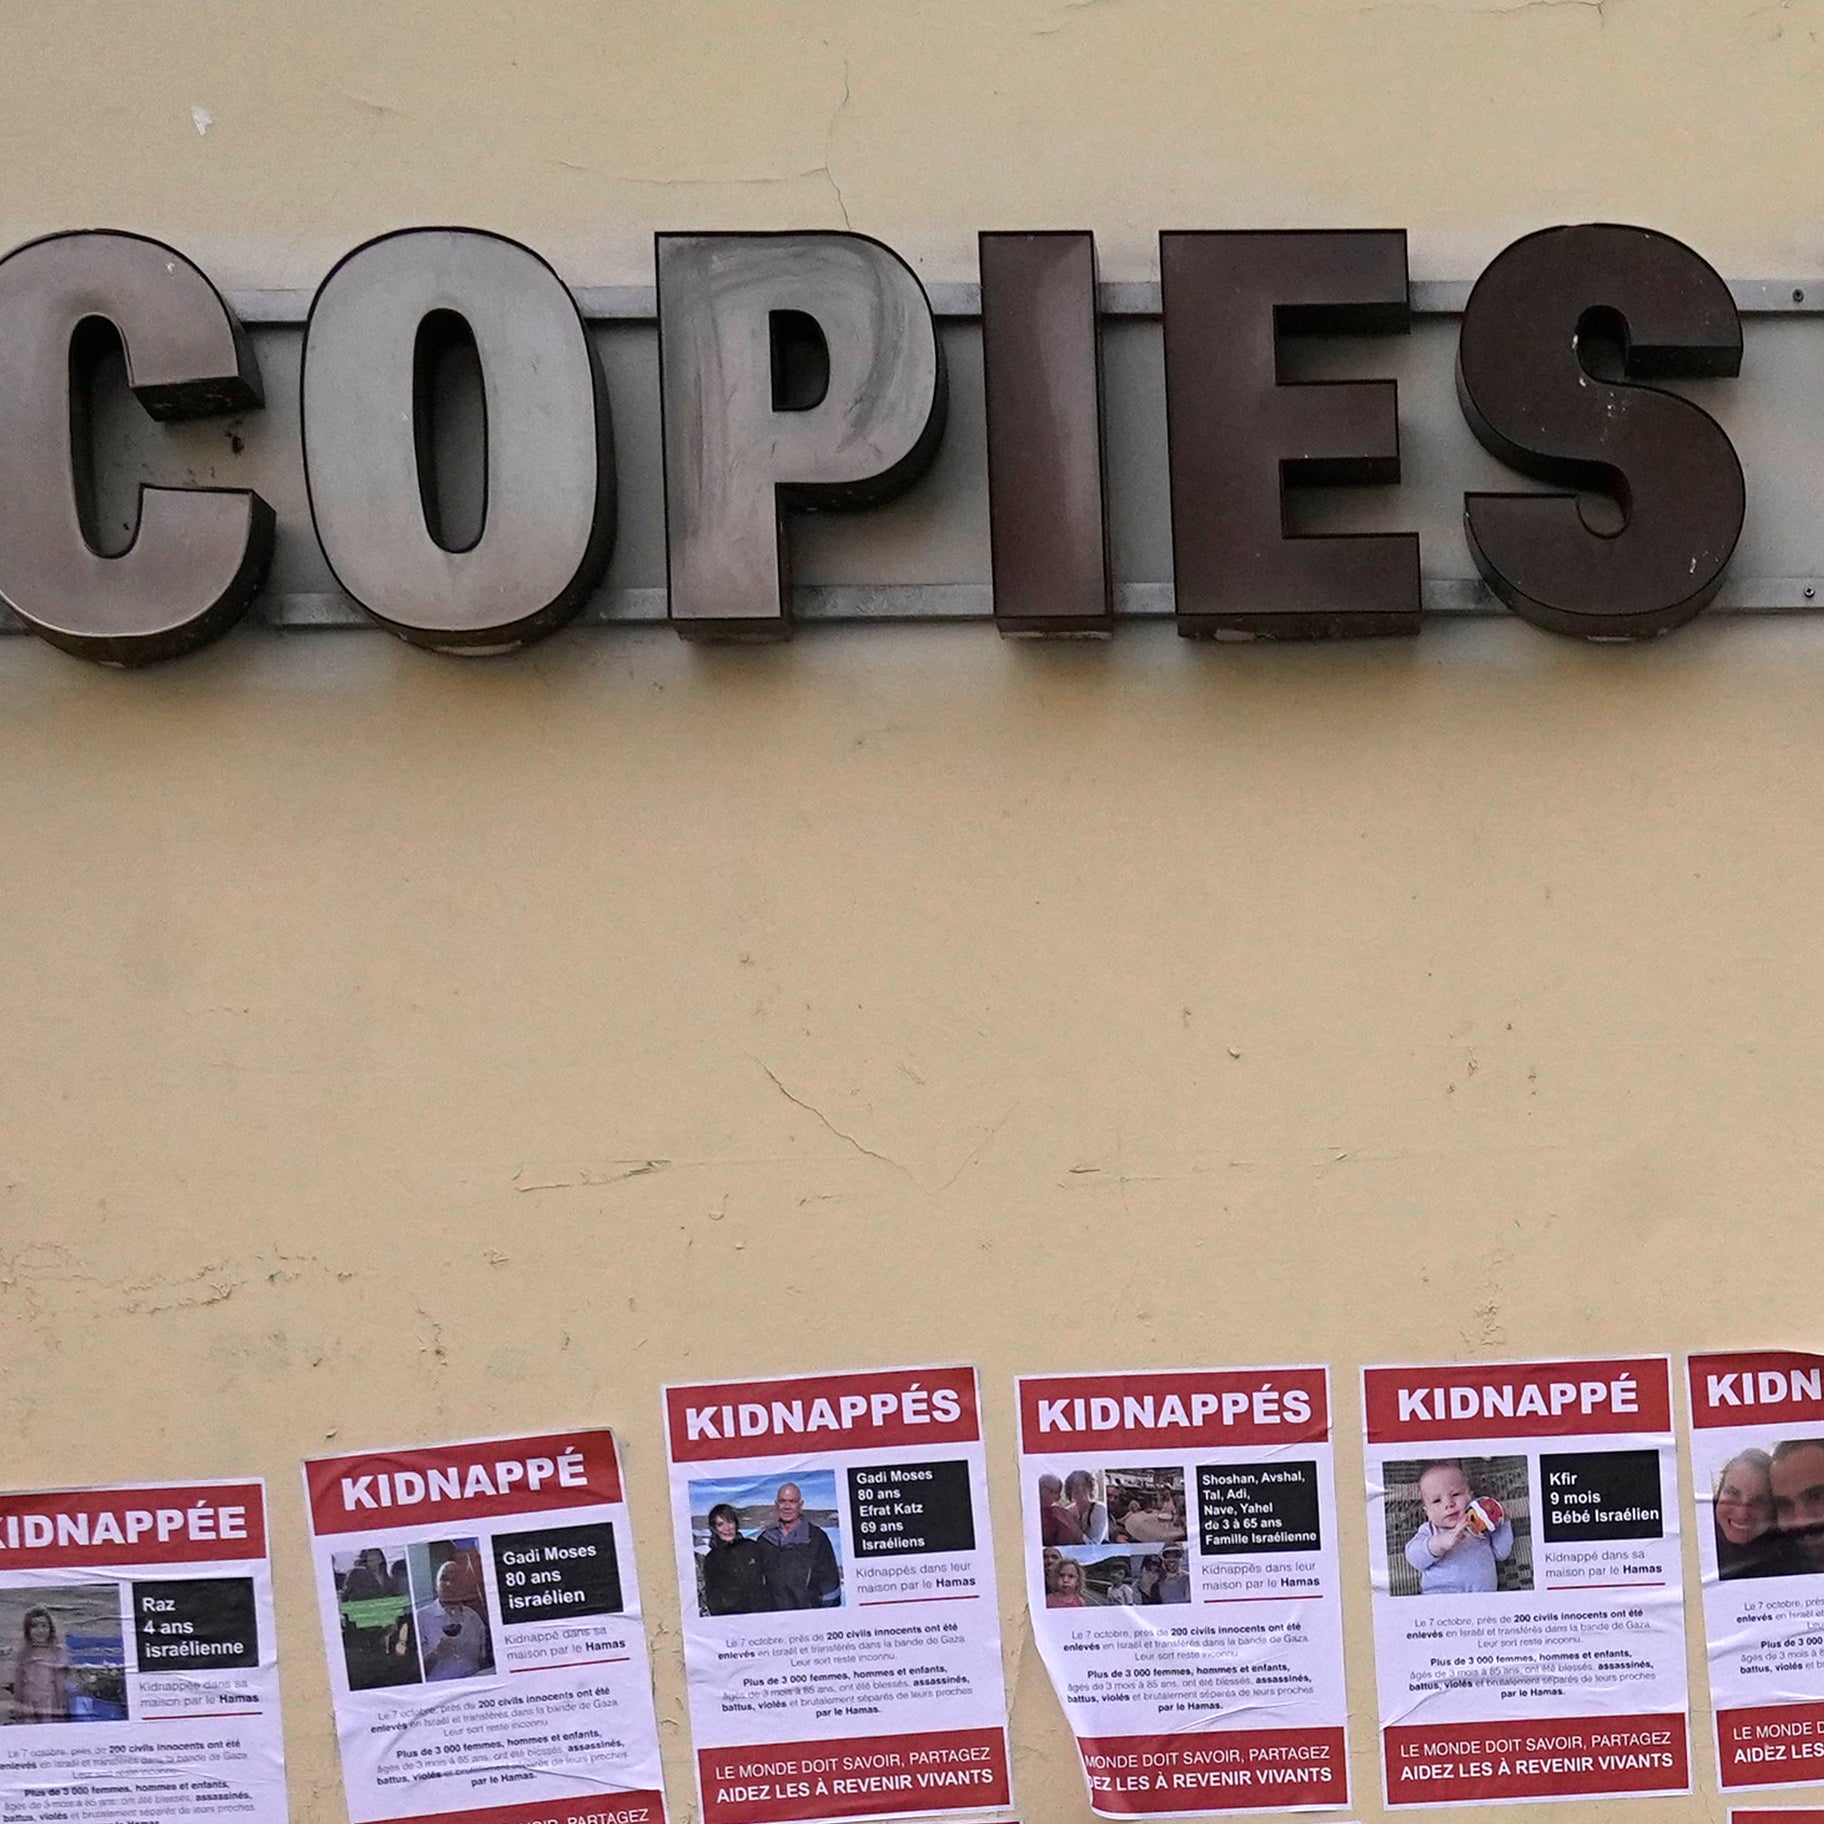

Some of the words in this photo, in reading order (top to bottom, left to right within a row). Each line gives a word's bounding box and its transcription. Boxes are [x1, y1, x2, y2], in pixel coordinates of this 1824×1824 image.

[0, 223, 1747, 655] COPIES
[1398, 1373, 1638, 1421] KIDNAPPÉ
[686, 1383, 960, 1440] KIDNAPPÉS
[1039, 1384, 1311, 1432] KIDNAPPÉS
[342, 1447, 587, 1510] KIDNAPPÉ
[1550, 1472, 1577, 1485] Kfir
[1551, 1492, 1559, 1505] 9
[1564, 1491, 1600, 1504] mois
[1552, 1510, 1590, 1524] Bébé
[1595, 1508, 1659, 1522] Israélien
[503, 1549, 540, 1565] Gadi
[545, 1546, 596, 1560] Moses
[506, 1571, 525, 1586] 80
[531, 1571, 561, 1584] ans
[143, 1598, 175, 1612] Raz
[509, 1589, 585, 1608] israélien
[144, 1620, 155, 1634] 4
[160, 1622, 193, 1634] ans
[146, 1641, 243, 1657] israélienne
